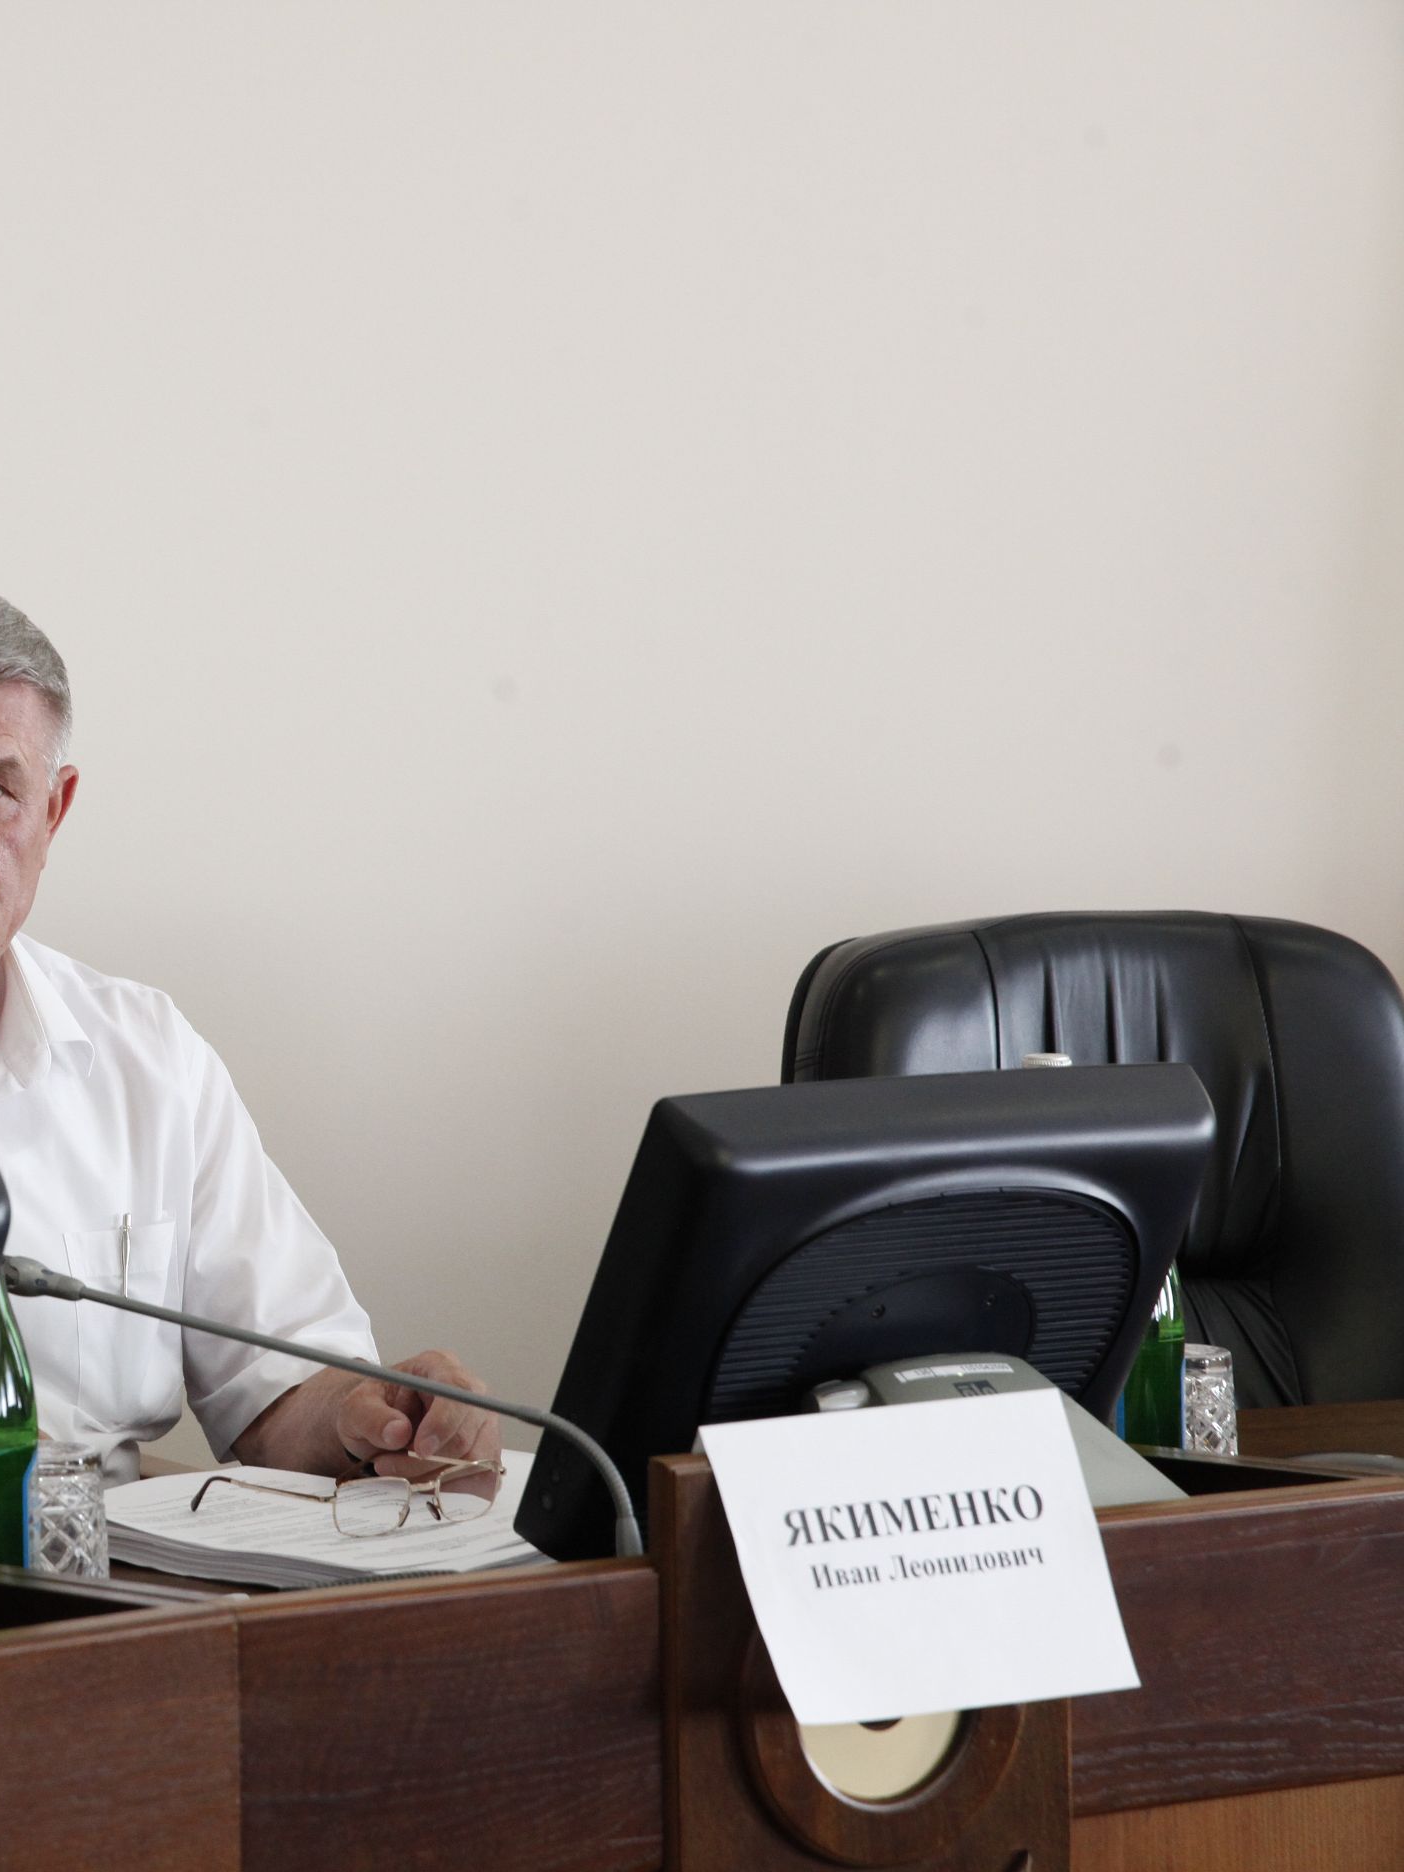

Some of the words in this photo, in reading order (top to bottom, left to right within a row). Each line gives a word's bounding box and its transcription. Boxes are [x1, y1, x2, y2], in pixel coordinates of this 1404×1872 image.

[784, 1484, 1044, 1547] ЯКИМЕНКО
[811, 1563, 881, 1589] Иван
[889, 1547, 1045, 1582] Леонидович
